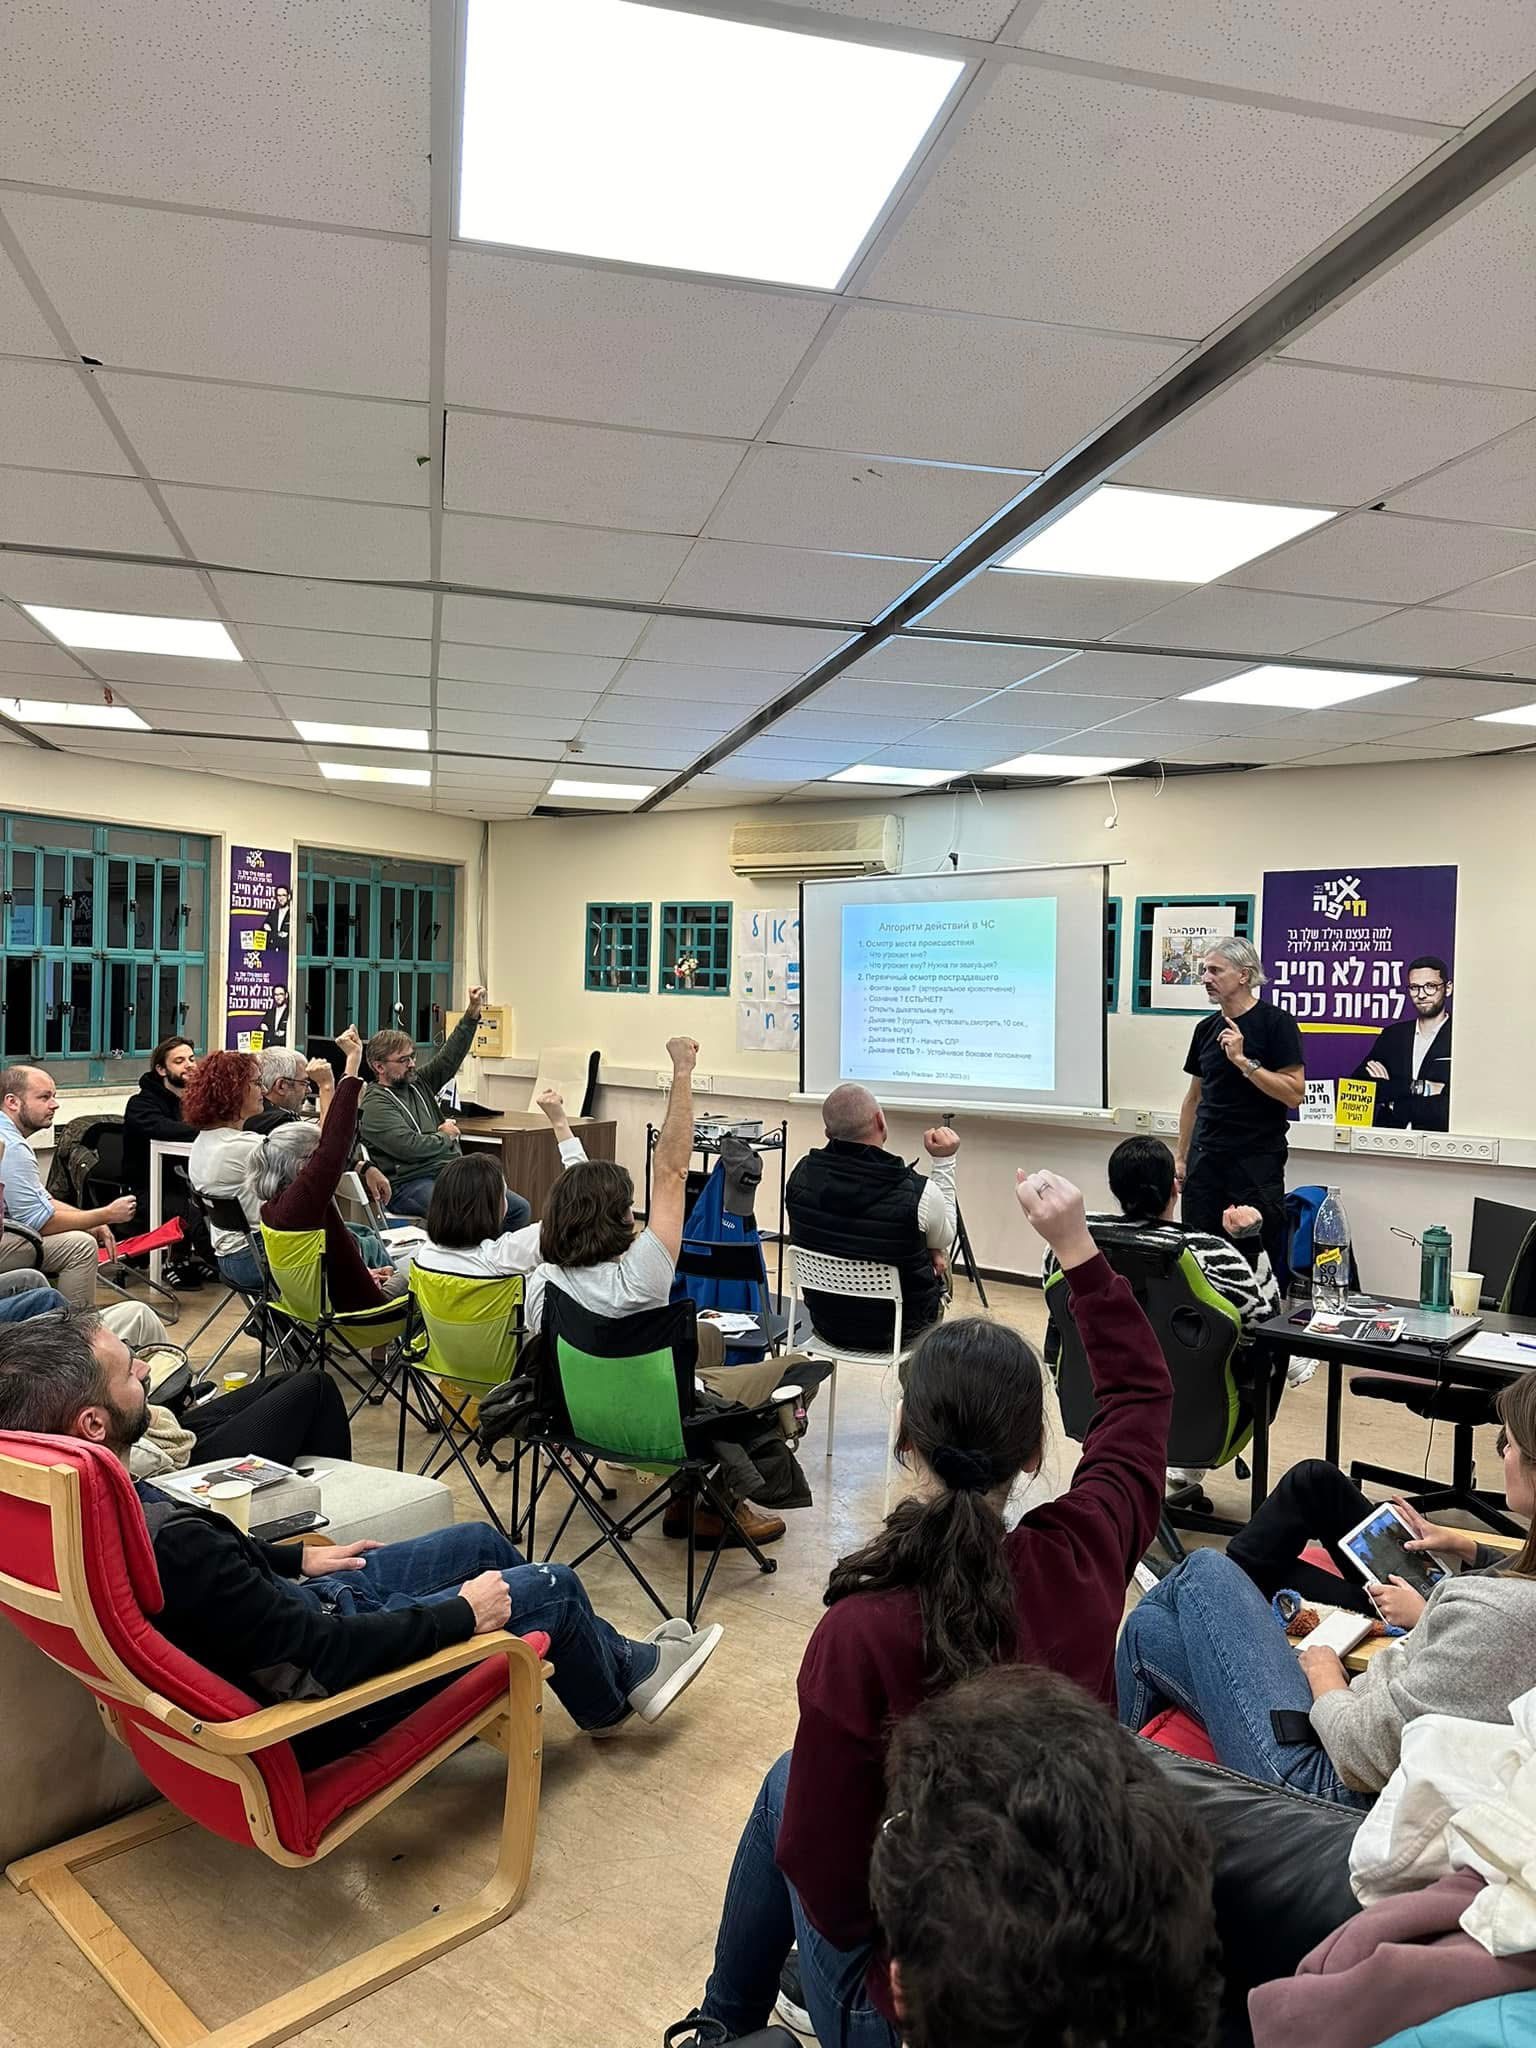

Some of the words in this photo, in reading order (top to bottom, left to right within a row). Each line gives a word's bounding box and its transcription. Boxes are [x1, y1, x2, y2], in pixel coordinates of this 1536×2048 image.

[233, 882, 251, 895] חייב
[252, 883, 264, 896] לא
[265, 886, 276, 897] זה
[253, 897, 276, 910] להיות
[879, 922, 923, 933] Алгоритм
[924, 920, 970, 931] действий
[981, 919, 996, 929] ЧС
[1287, 929, 1298, 940] גר
[1300, 927, 1319, 941] שלך
[1321, 927, 1343, 940] הילד
[1345, 928, 1370, 940] בעצם
[1372, 927, 1392, 940] למה
[866, 940, 893, 949] Осмотр
[895, 940, 916, 948] места
[918, 939, 975, 948] происшествия
[1287, 940, 1311, 954] לידך?
[1313, 940, 1330, 952] בית
[1331, 939, 1347, 952] ולא
[1348, 940, 1370, 952] אביב
[1372, 938, 1392, 952] בתל
[866, 973, 907, 982] Первичный
[909, 974, 937, 982] осмотр
[938, 974, 999, 982] пострадавшего
[1273, 960, 1326, 986] חייב
[1331, 956, 1365, 986] לא
[1372, 961, 1404, 987] זה
[230, 985, 248, 996] חייב
[250, 984, 261, 997] לא
[263, 985, 274, 997] זה
[250, 997, 274, 1010] להיות
[1271, 989, 1326, 1017] ככה!
[1333, 988, 1406, 1019] להיות
[896, 1047, 915, 1055] ЕСТЬ
[1308, 1083, 1324, 1093] אני
[1319, 1094, 1330, 1105] חי
[1320, 1265, 1337, 1275] SO
[1320, 1275, 1336, 1285] DA
